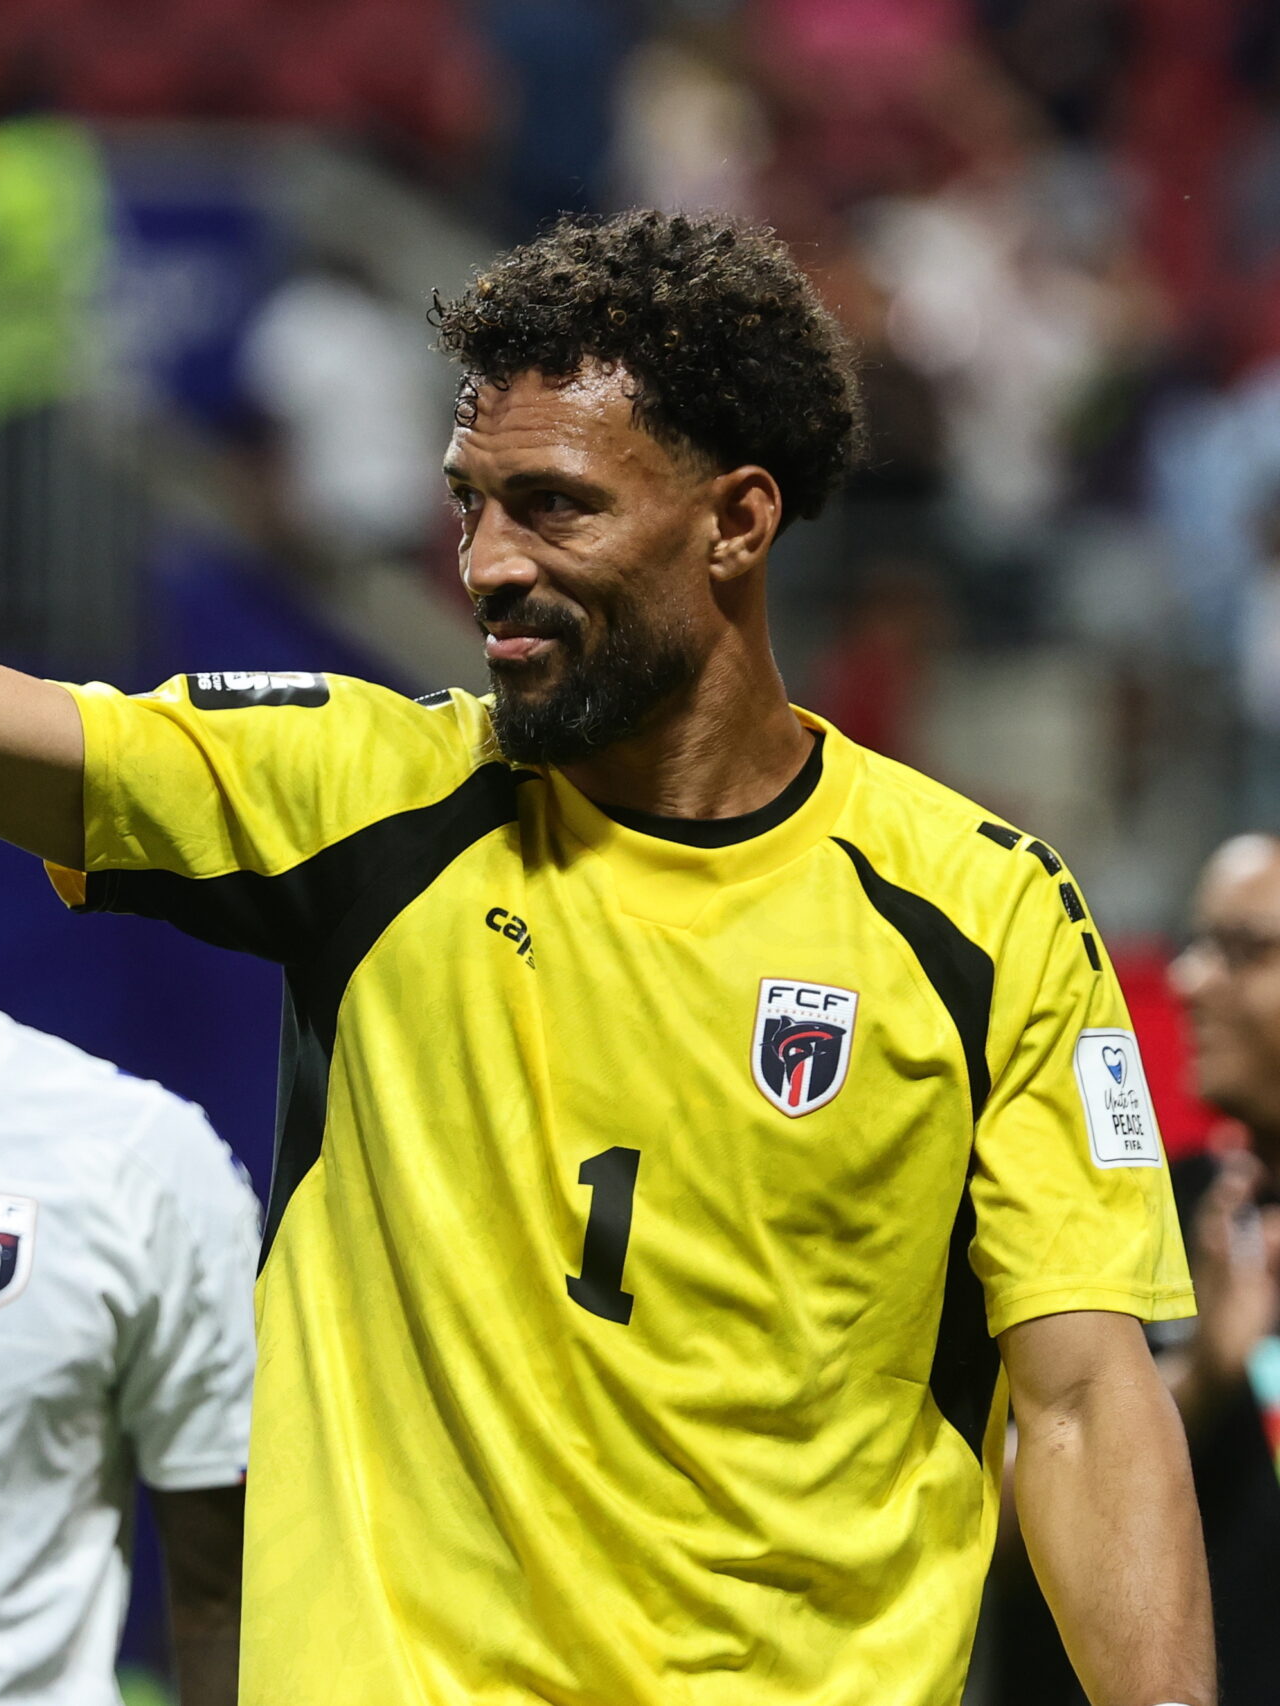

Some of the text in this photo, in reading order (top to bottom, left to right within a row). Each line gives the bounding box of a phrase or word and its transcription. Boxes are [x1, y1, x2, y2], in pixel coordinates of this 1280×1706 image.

[768, 986, 849, 1011] FCF
[1112, 1114, 1144, 1136] PEACE
[1124, 1140, 1143, 1151] FIFA
[565, 1146, 641, 1326] 1
